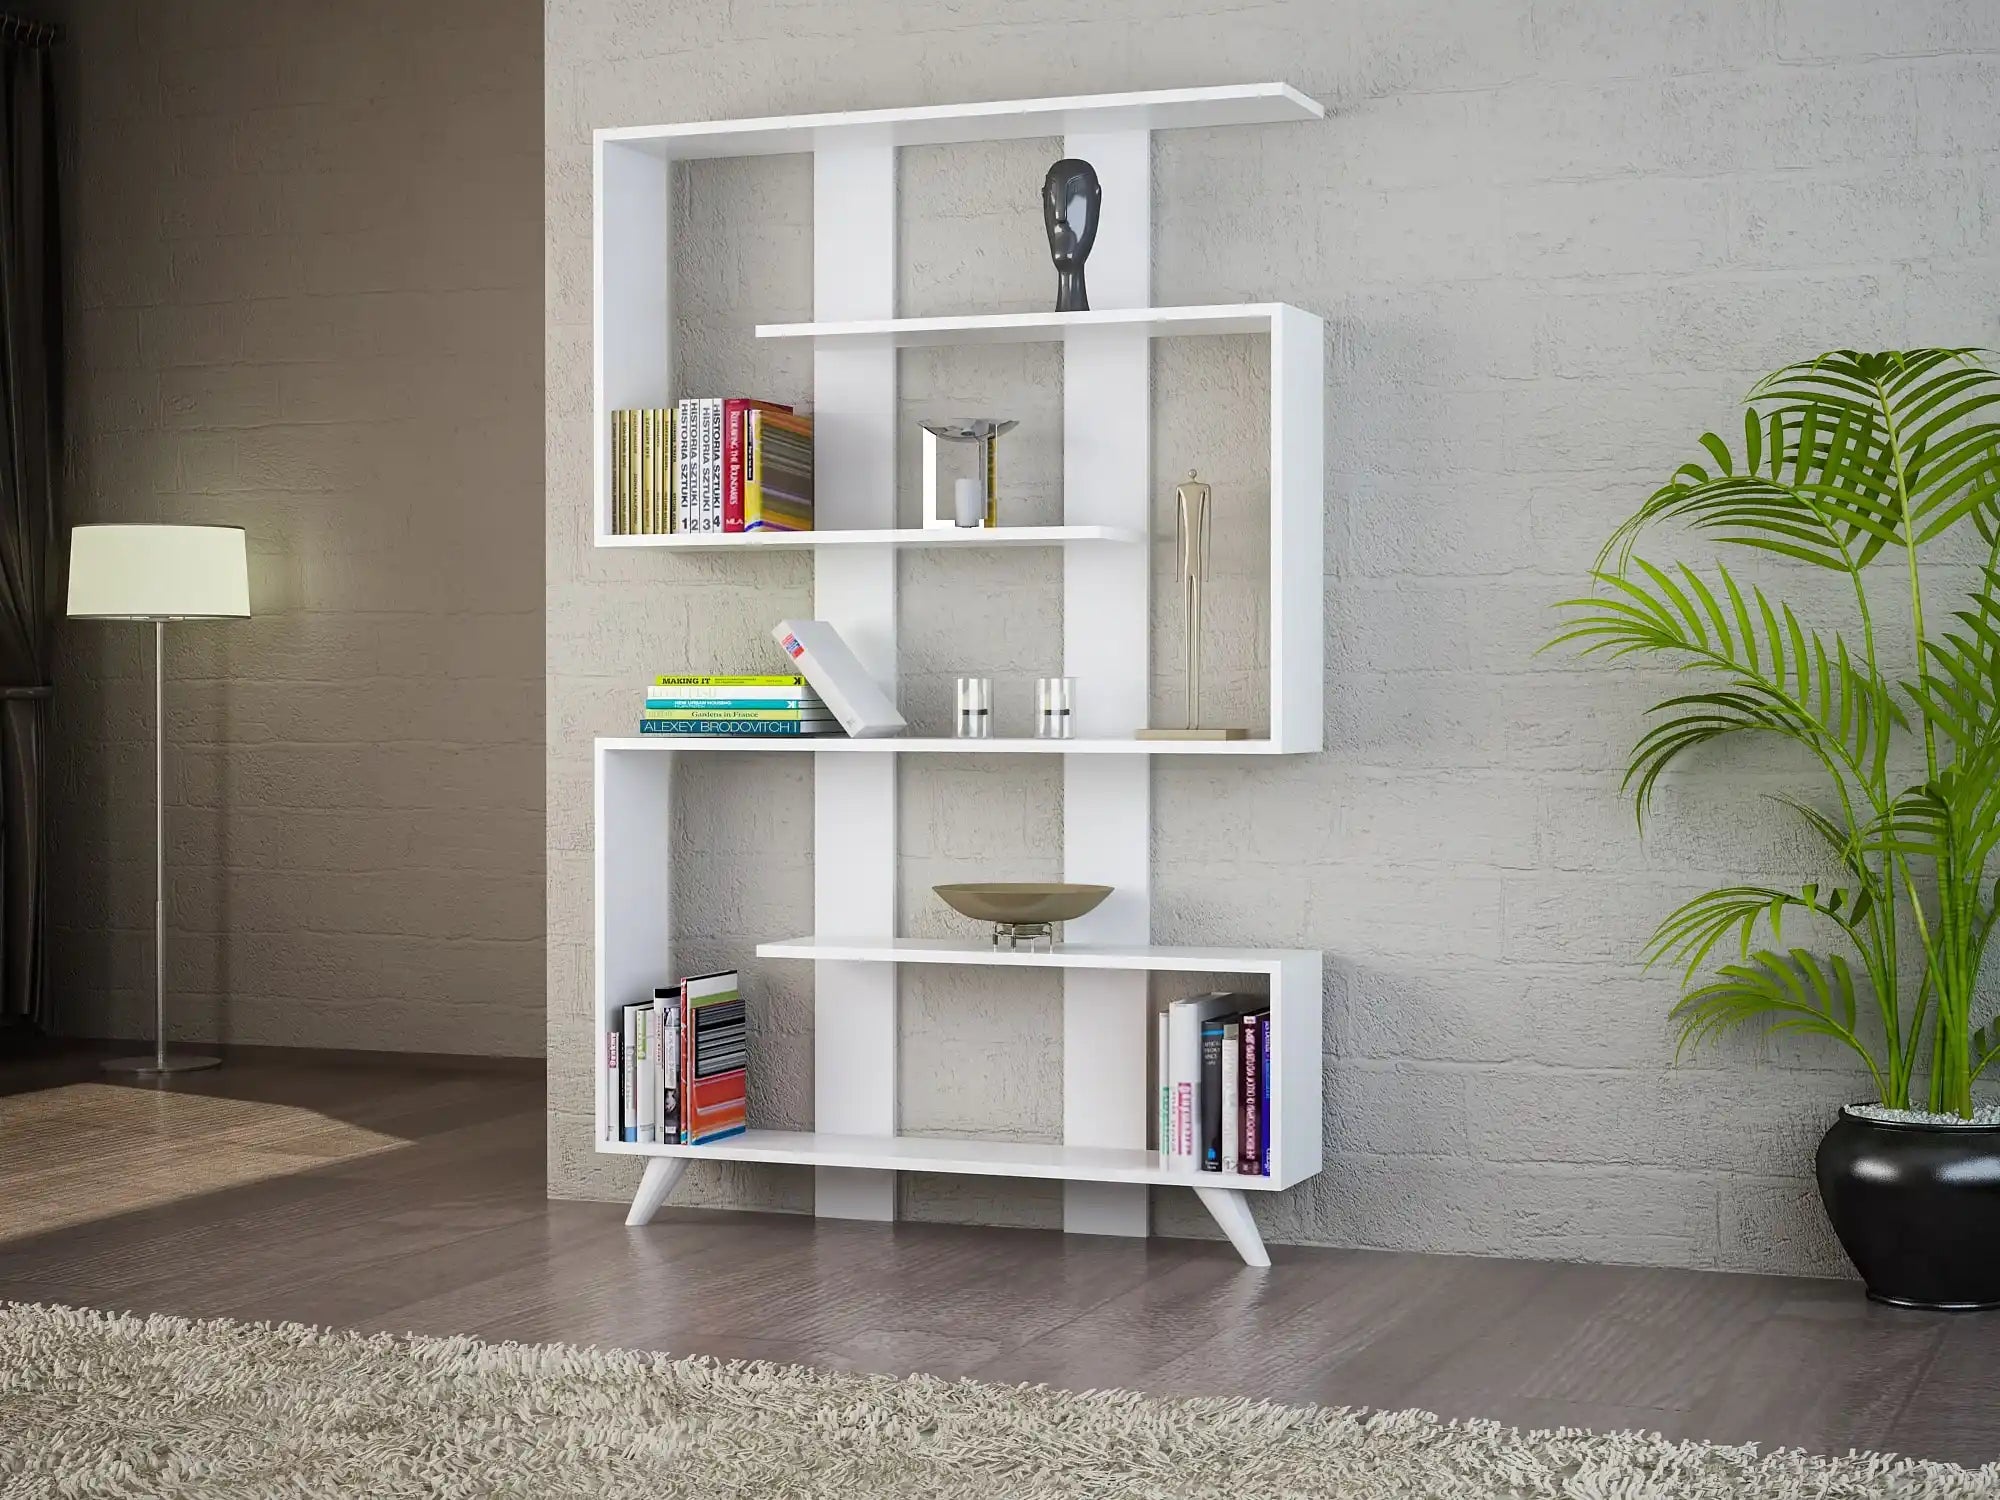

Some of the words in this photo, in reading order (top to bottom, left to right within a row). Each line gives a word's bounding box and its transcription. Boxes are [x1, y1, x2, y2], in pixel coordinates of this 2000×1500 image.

[713, 404, 721, 461] HISTORIA
[713, 465, 721, 508] SZTUKI
[681, 518, 687, 529] 1
[691, 519, 698, 530] 2
[703, 519, 711, 530] 3
[713, 516, 721, 527] 4
[644, 721, 696, 732] ALEXEY
[701, 721, 790, 732] BRODOVITCH
